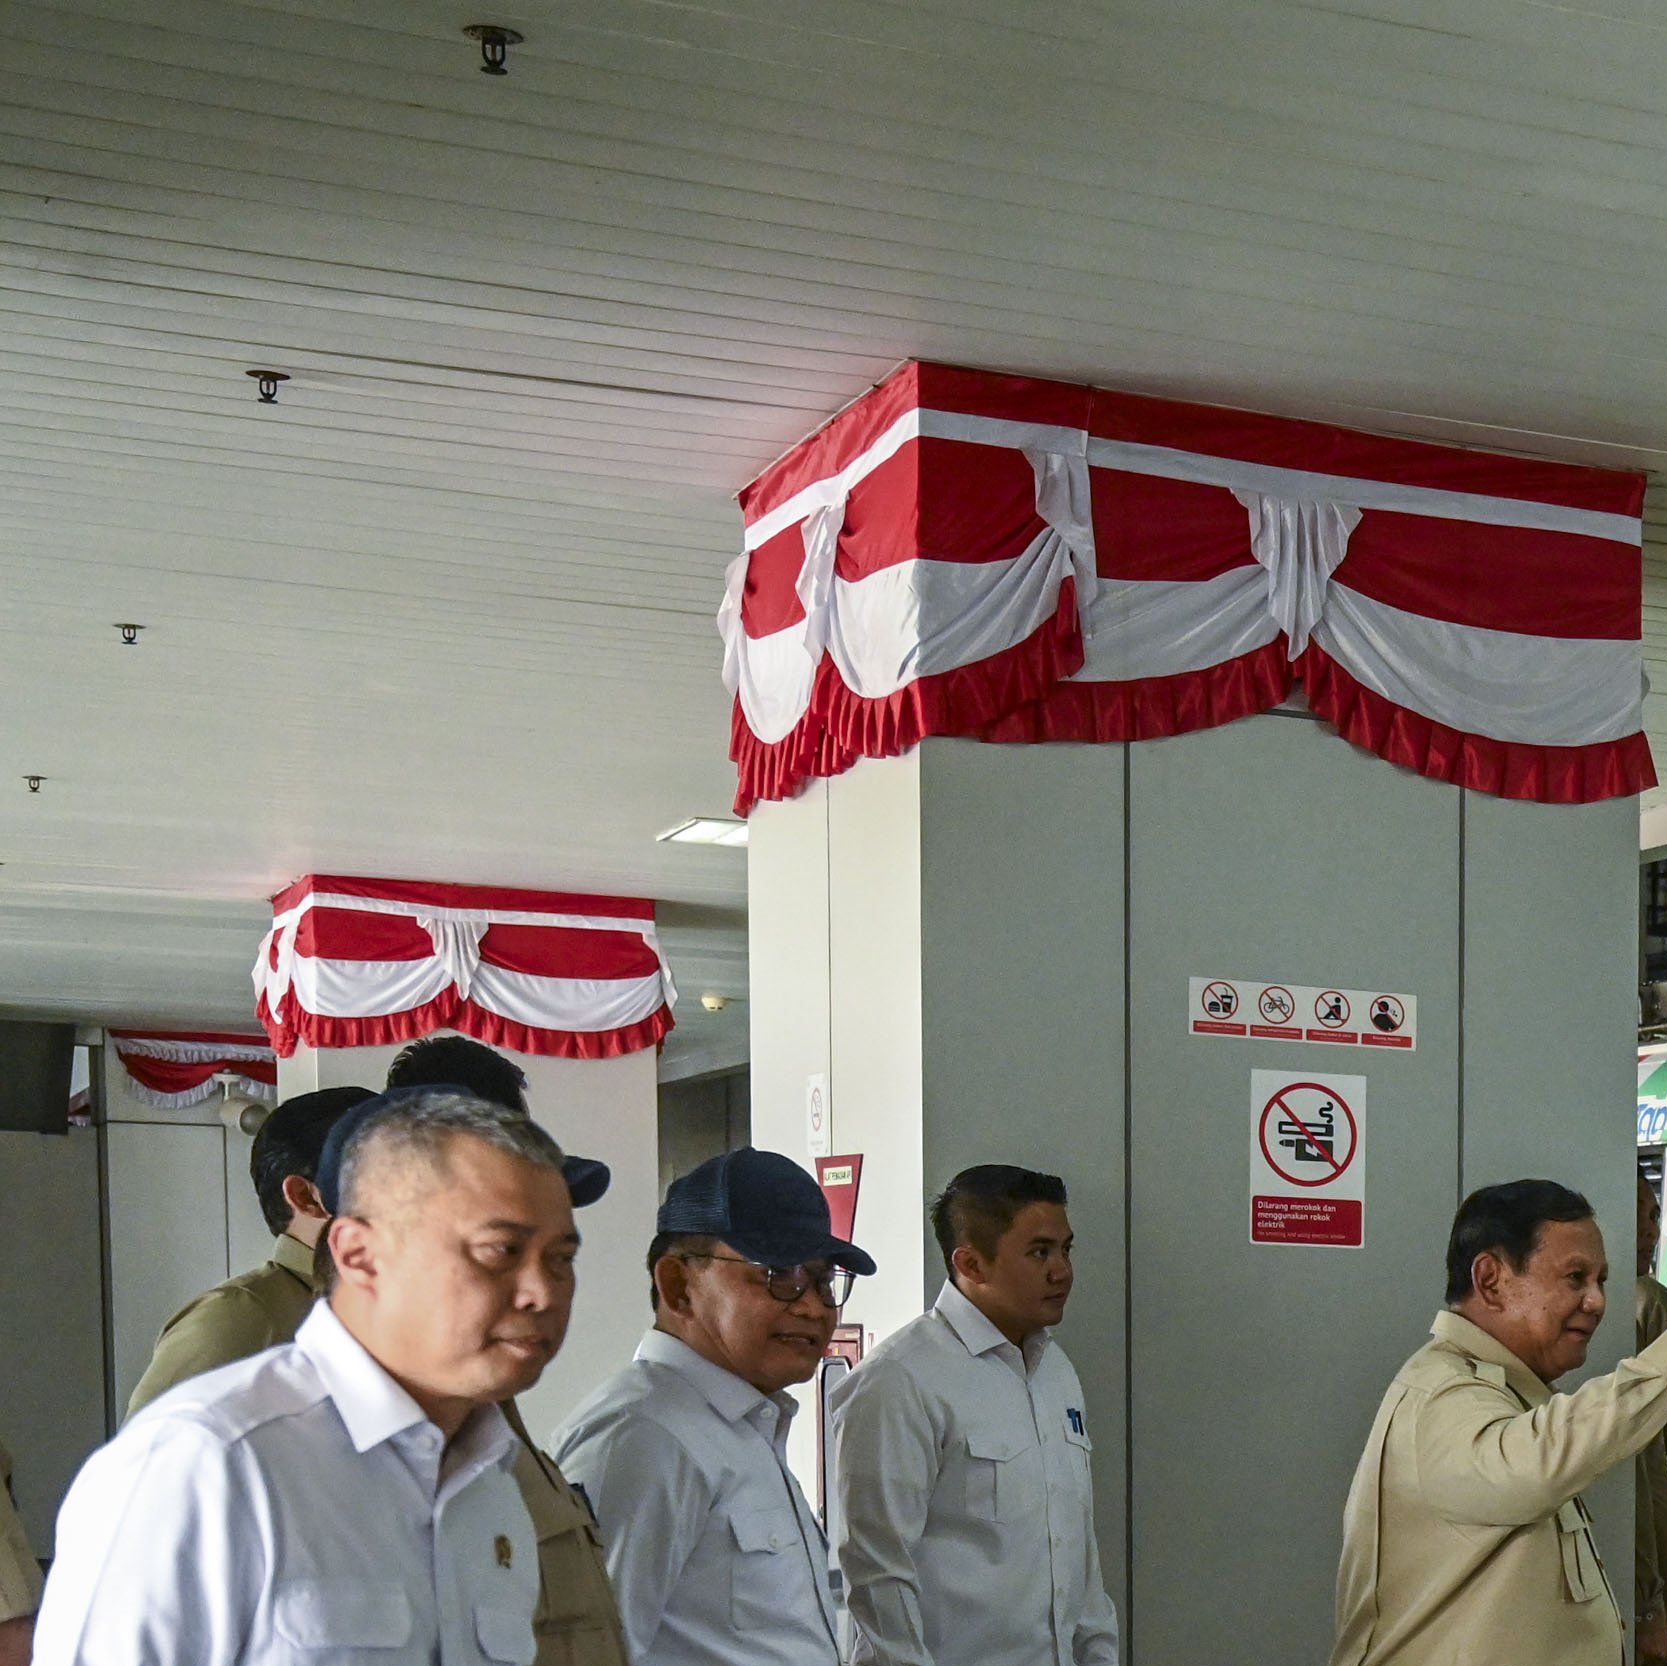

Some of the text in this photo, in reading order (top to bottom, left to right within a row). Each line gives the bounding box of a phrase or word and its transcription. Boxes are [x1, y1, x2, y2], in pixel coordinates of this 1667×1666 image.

[1257, 1201, 1337, 1212] Dilarang merokok dan
[1257, 1212, 1309, 1221] menggunakan
[1257, 1220, 1286, 1228] elektrik
